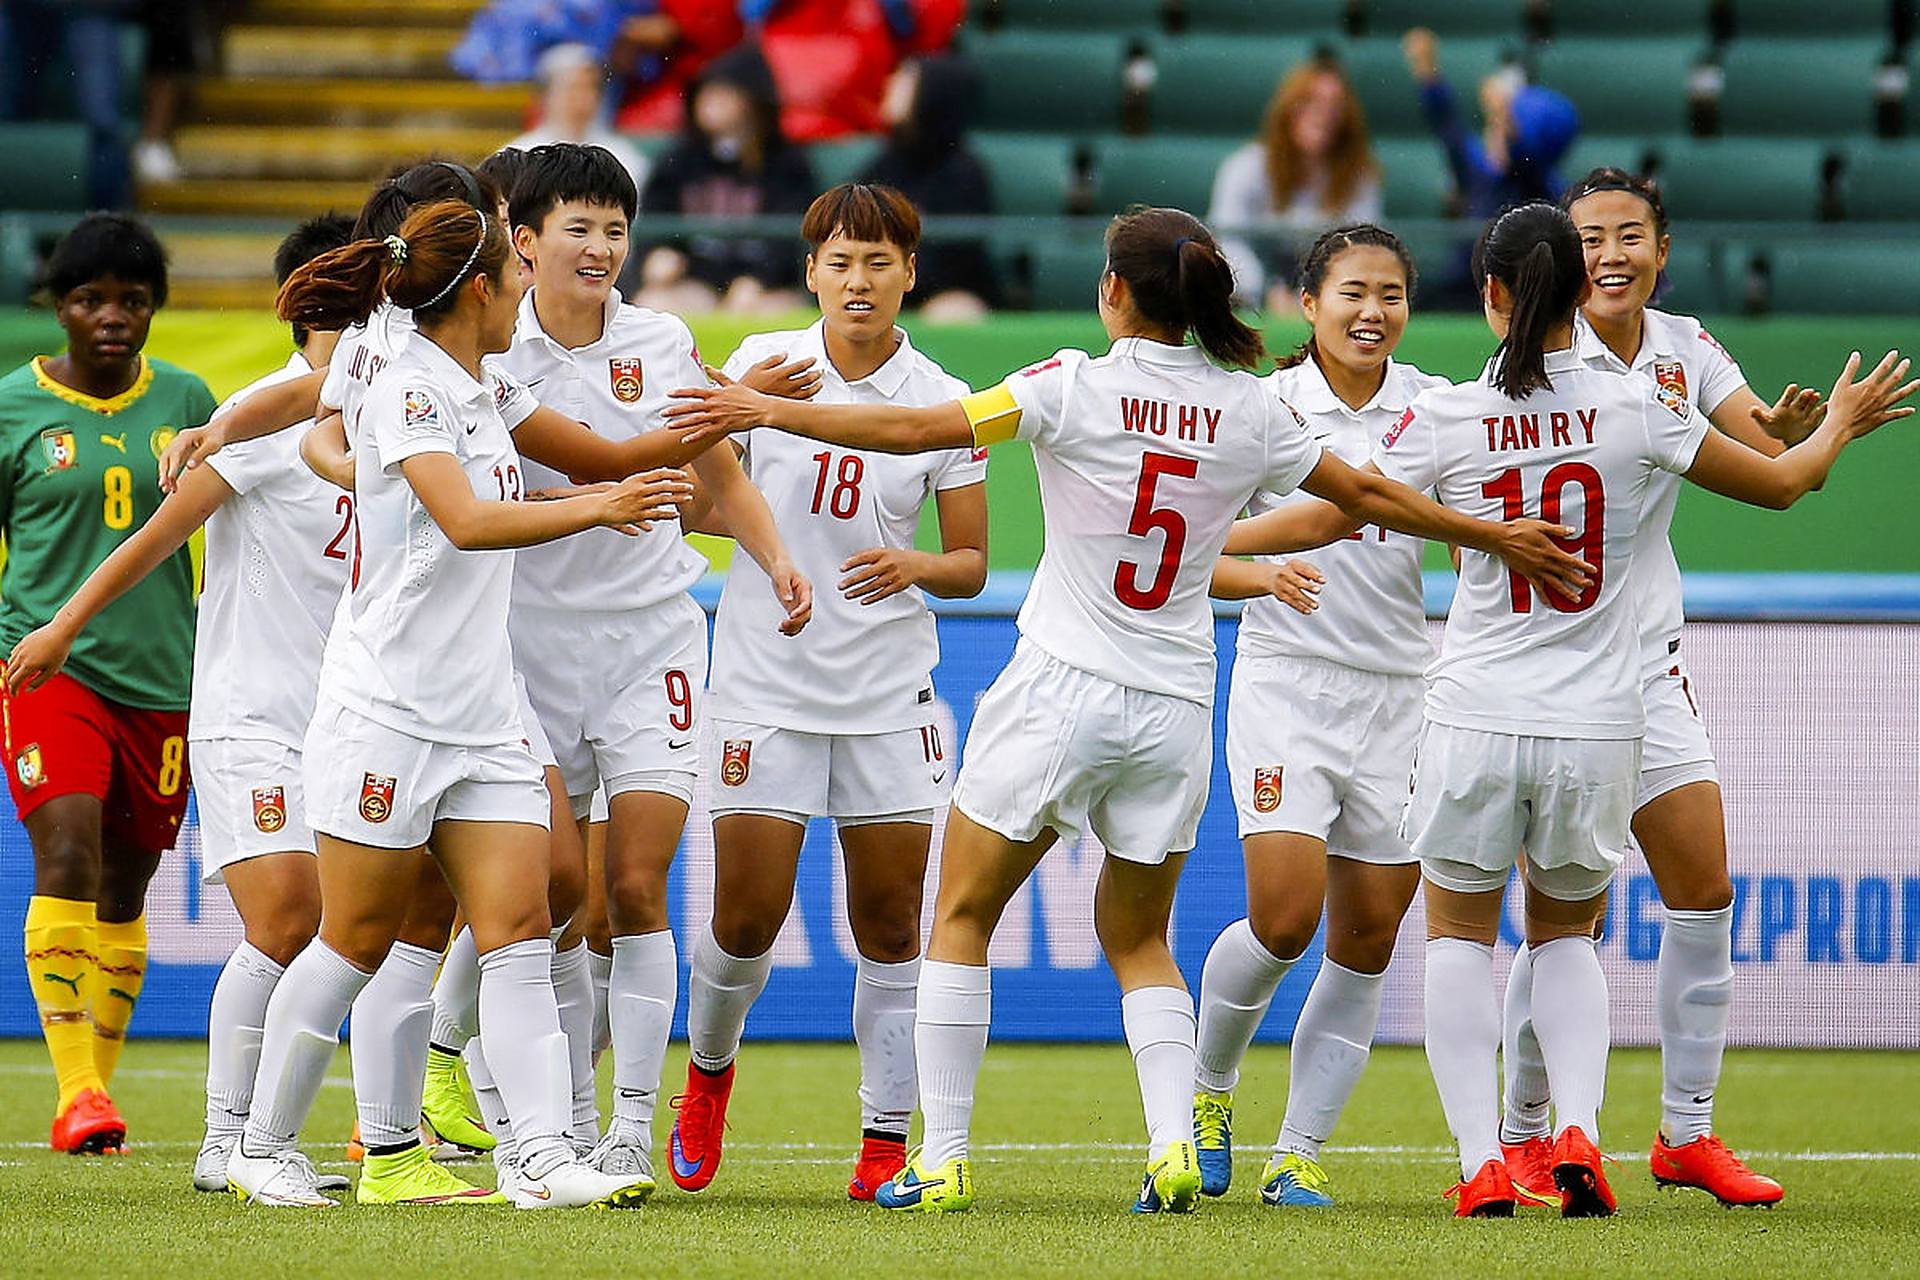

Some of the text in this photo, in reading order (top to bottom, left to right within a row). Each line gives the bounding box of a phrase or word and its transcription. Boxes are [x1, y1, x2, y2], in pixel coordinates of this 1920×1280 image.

[1121, 397, 1222, 444] WU HY
[1482, 412, 1540, 451] TAN
[104, 466, 133, 530] 8
[811, 450, 864, 520] 18
[1113, 451, 1199, 611] 5
[1481, 462, 1606, 613] 19
[665, 670, 692, 731] 9
[158, 736, 184, 796] 8
